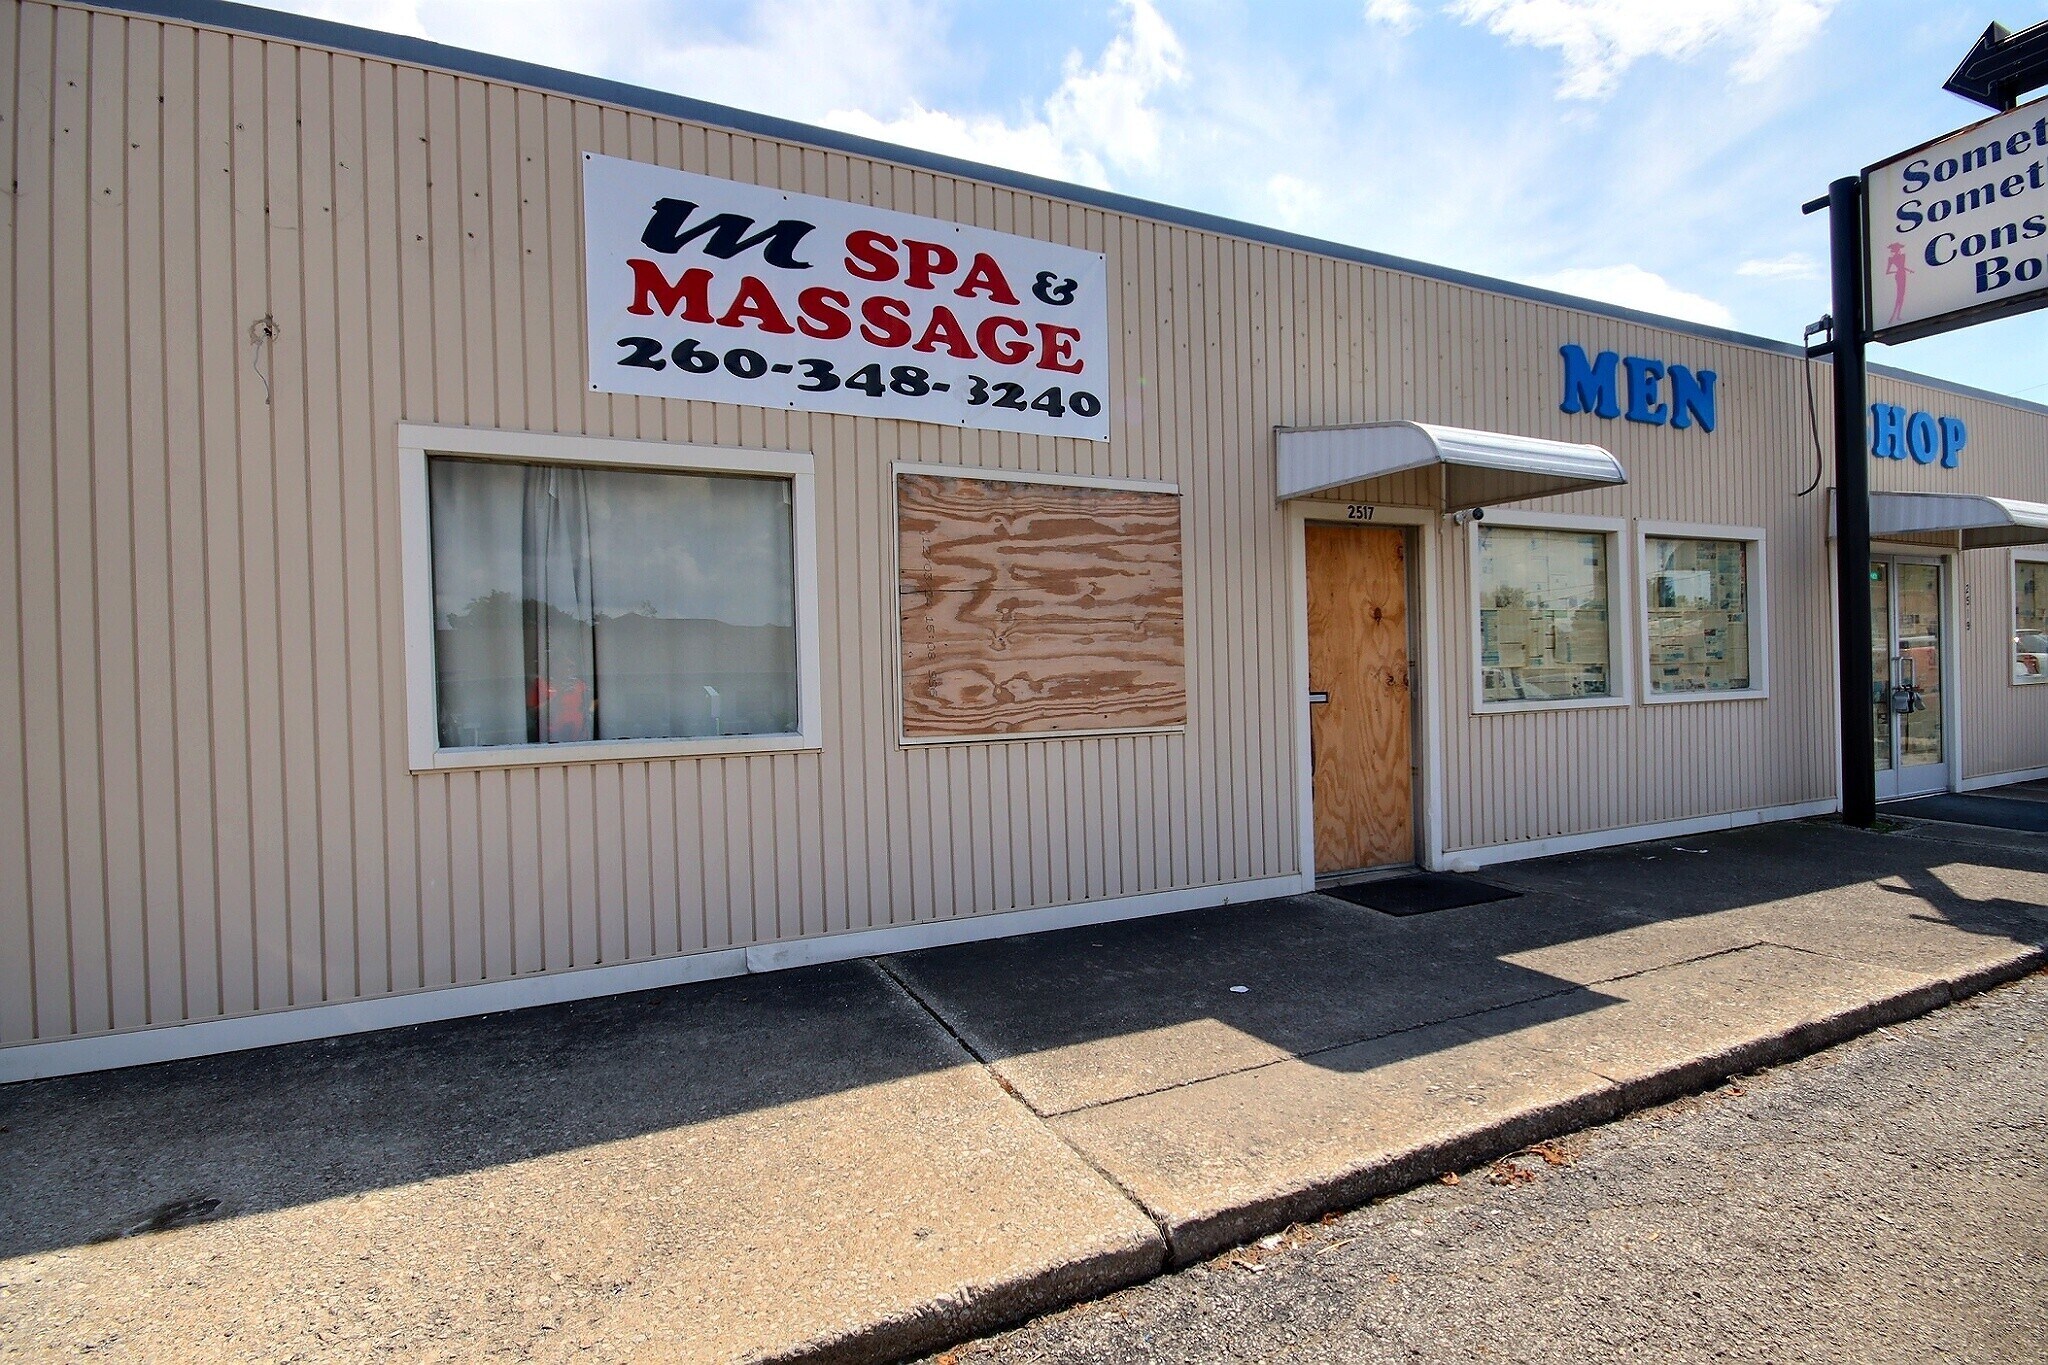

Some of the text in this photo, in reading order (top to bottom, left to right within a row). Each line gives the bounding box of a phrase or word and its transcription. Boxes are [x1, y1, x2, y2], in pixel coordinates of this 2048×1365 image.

[1896, 157, 2048, 233] Somet
[844, 230, 1021, 306] SPA
[1031, 270, 1078, 306] &
[1924, 214, 2047, 267] Cons
[1975, 253, 2048, 294] Bo
[626, 258, 1084, 375] MASSAGE
[1559, 343, 1967, 469] MEN HOP
[1347, 504, 1375, 520] 2517
